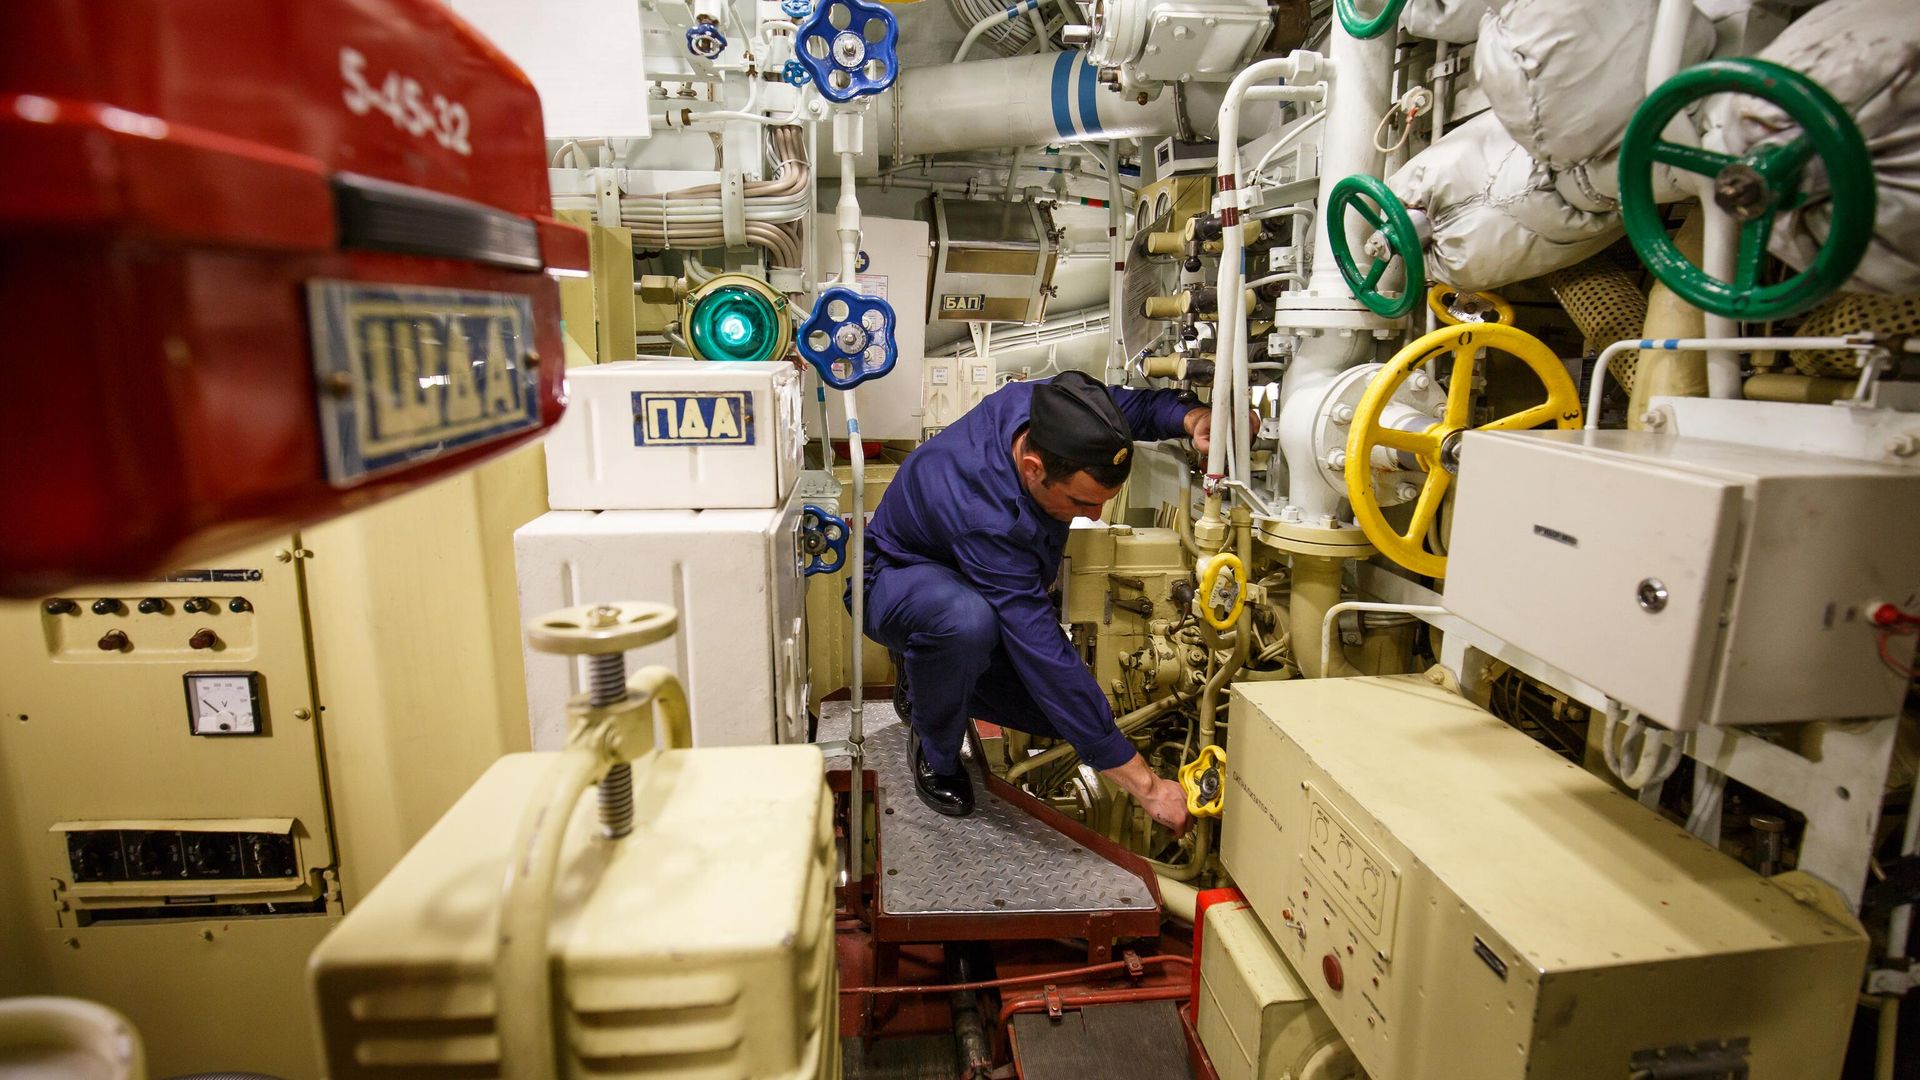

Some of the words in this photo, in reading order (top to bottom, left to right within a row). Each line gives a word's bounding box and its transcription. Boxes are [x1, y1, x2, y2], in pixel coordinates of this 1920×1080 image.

[339, 47, 473, 156] 5-45-32
[946, 297, 979, 309] БАП
[364, 316, 516, 435] ШДА
[647, 397, 739, 439] ПДА
